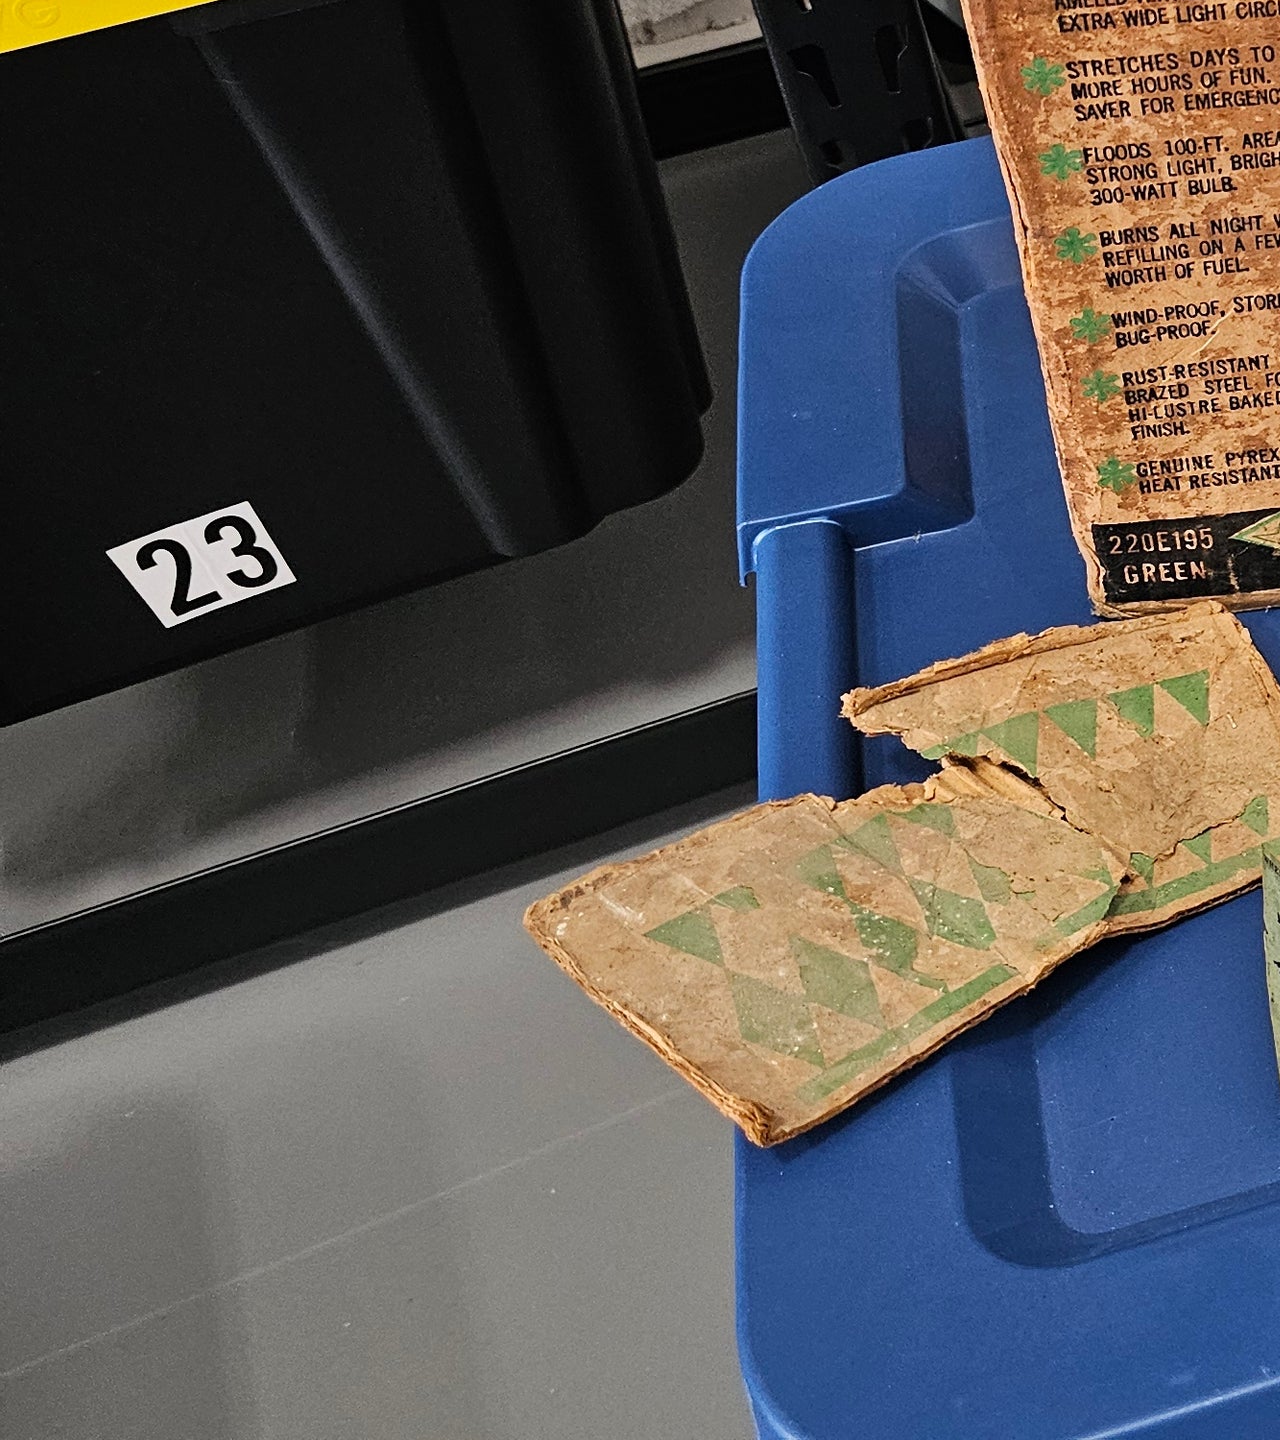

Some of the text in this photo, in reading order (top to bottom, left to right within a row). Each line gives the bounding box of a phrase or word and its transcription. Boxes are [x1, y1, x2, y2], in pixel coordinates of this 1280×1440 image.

[1059, 14, 1116, 33] EXTRA
[1124, 9, 1169, 27] WIDE
[1176, 4, 1228, 23] LIGHT
[1066, 53, 1179, 79] STRETCHES
[1190, 49, 1240, 67] DAYS
[1250, 46, 1275, 63] TO
[1071, 81, 1122, 100] MORE
[1132, 75, 1192, 93] HOURS
[1200, 72, 1223, 88] OF
[1230, 67, 1272, 85] FUN.
[1074, 101, 1131, 121] SAVER
[1141, 97, 1175, 114] FOR
[1083, 143, 1151, 163] FLOODS
[1165, 136, 1229, 156] 100-FT.
[1087, 163, 1157, 184] STRONG
[1090, 176, 1238, 205] 300-WATT BULB.
[1100, 228, 1159, 247] BURNS
[1169, 221, 1199, 239] ALL
[1211, 215, 1263, 235] NIGHT
[1103, 245, 1190, 267] REFILLING
[1199, 240, 1224, 256] ON
[1234, 237, 1246, 253] A
[1104, 258, 1250, 288] WORTH OF FUEL.
[1111, 301, 1226, 327] WIND-PROOF,
[1115, 321, 1217, 349] BUG-PROOF.
[1122, 355, 1270, 387] RUST-RESISTANT
[1124, 384, 1189, 406] BRAZED
[1205, 376, 1253, 395] STEEL
[1128, 400, 1221, 422] HI-LUSTRE
[1131, 421, 1191, 440] FINISH.
[1136, 454, 1215, 477] GENUINE
[1226, 448, 1280, 465] PYREX
[1139, 477, 1181, 494] HEAT
[1109, 528, 1214, 555] 220E195
[136, 515, 277, 617] 23
[1123, 561, 1206, 586] GREEN
